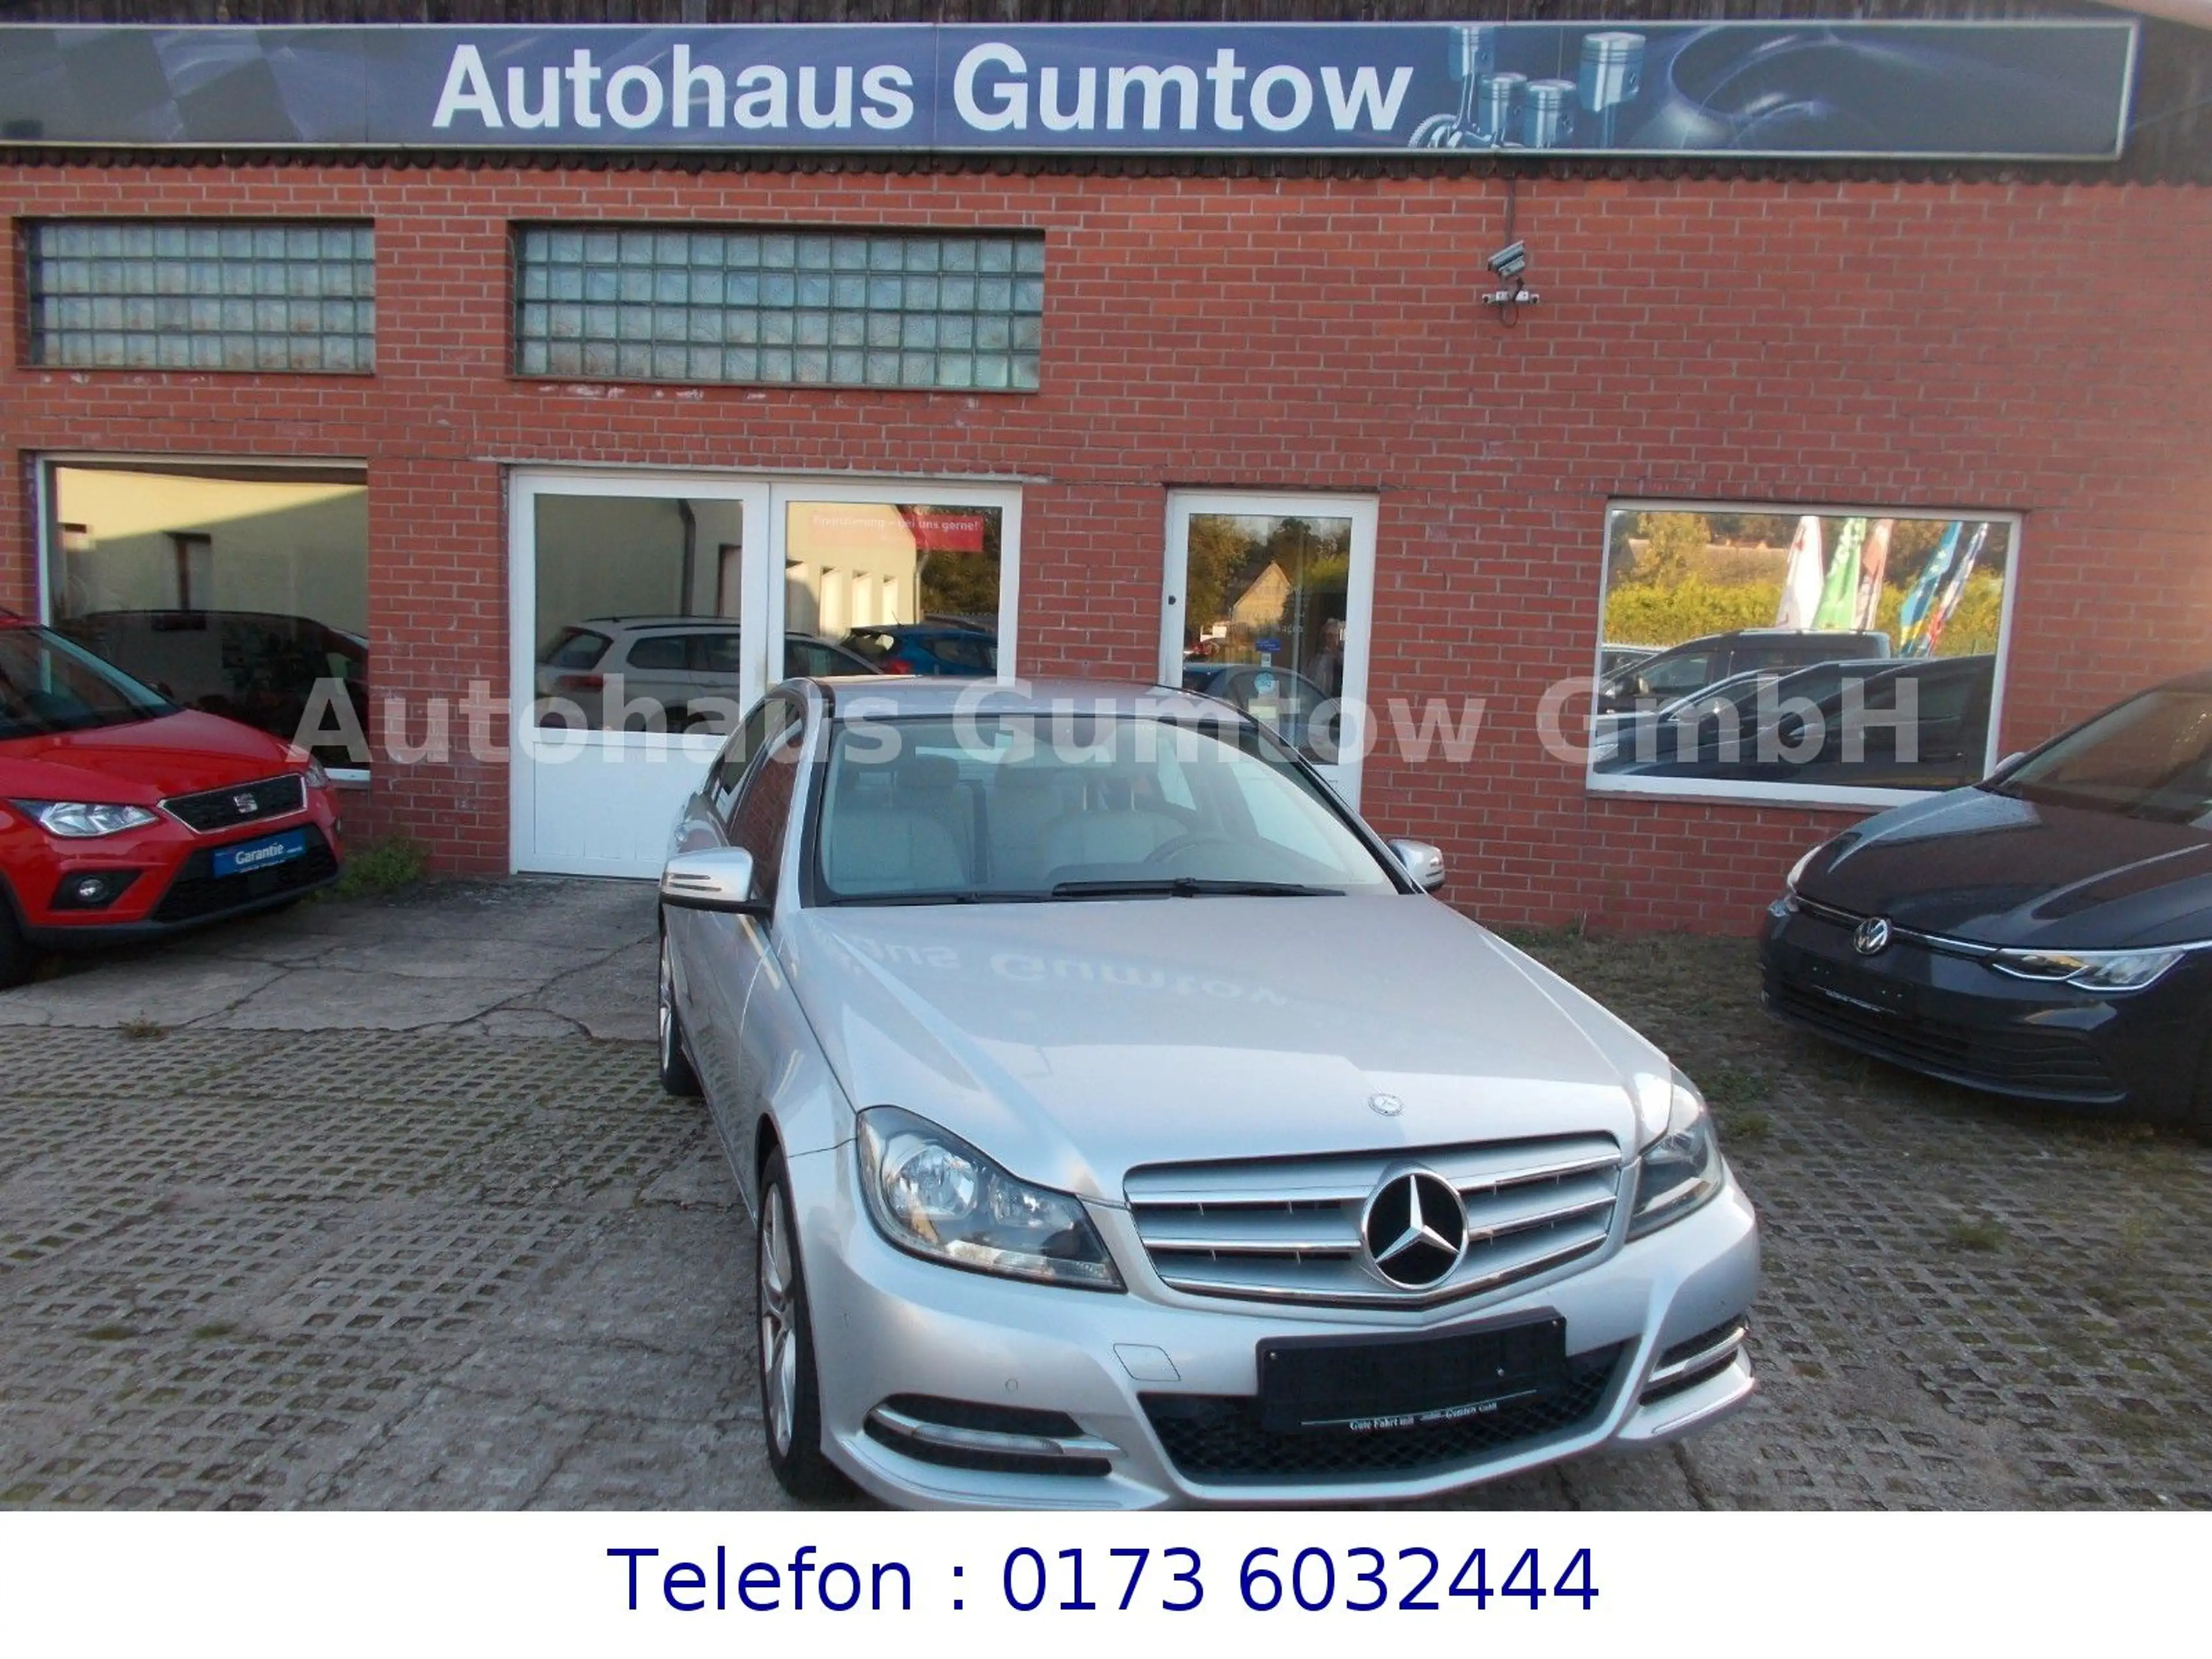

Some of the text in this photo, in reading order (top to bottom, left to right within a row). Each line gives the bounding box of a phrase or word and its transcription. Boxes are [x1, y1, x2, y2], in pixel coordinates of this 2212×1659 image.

[432, 42, 1415, 131] Autohaus Gumtow
[235, 842, 284, 864] Garantie
